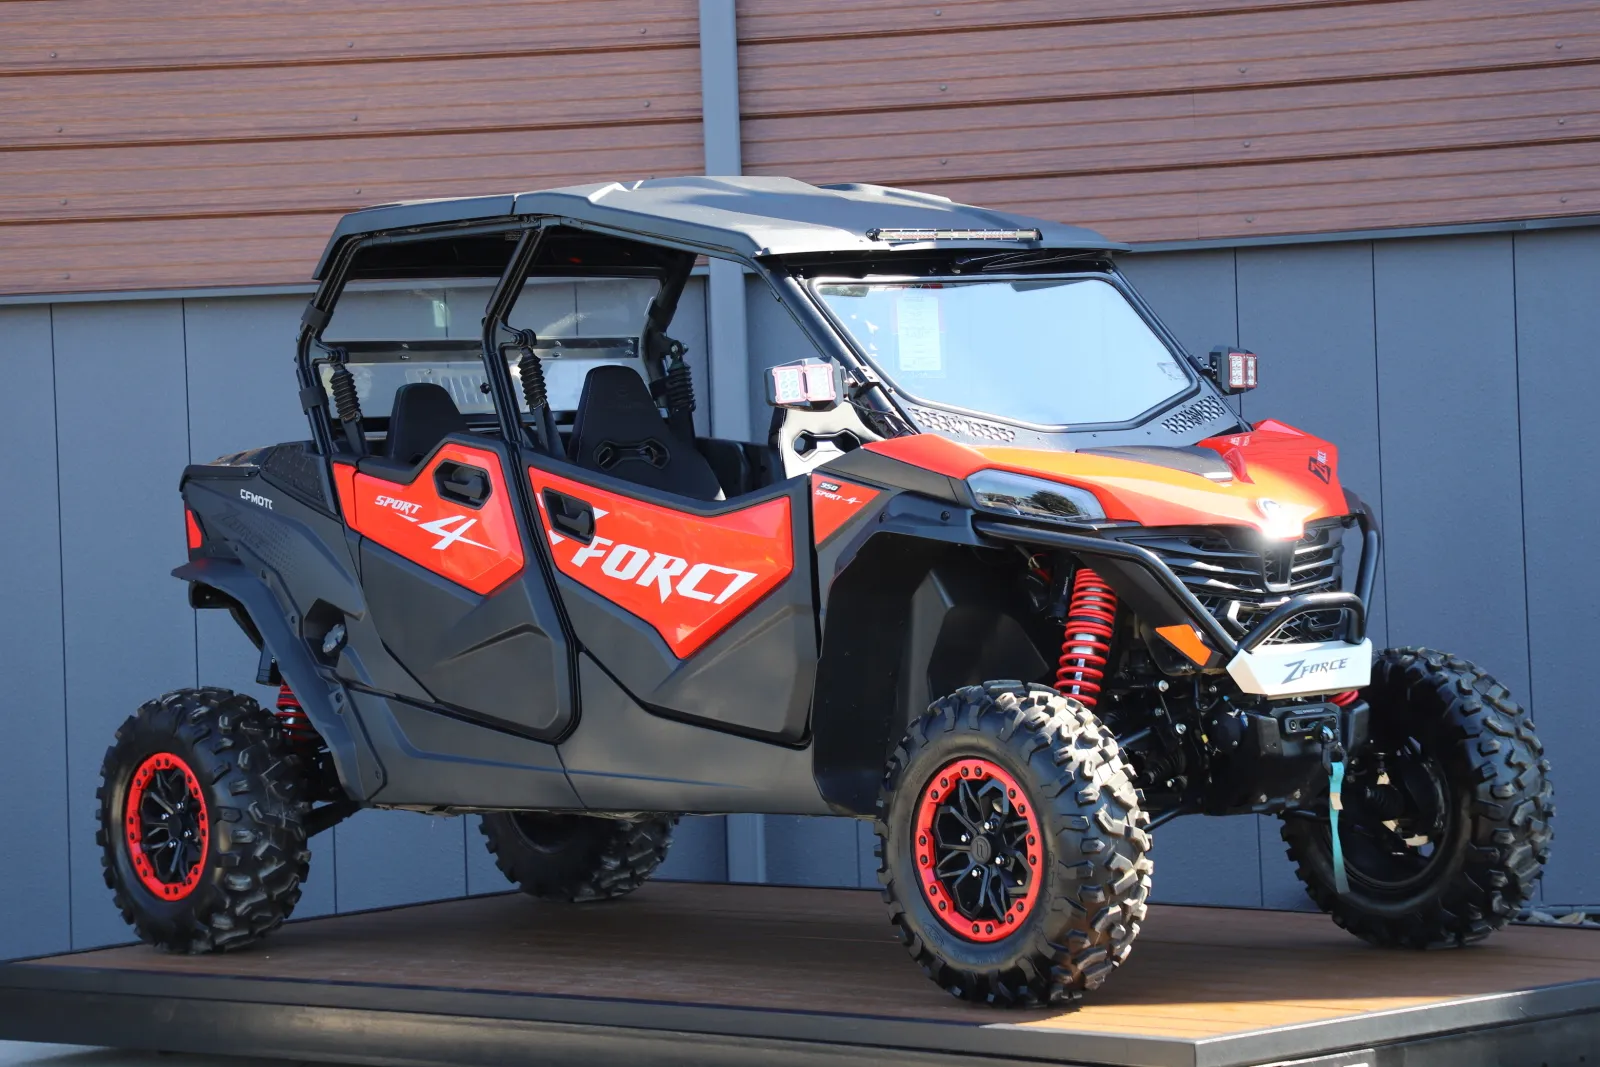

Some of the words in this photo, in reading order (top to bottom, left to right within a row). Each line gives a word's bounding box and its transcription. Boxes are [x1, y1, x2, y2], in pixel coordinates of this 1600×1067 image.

[374, 495, 423, 515] SPORT
[815, 490, 842, 500] SPORT
[417, 514, 499, 551] 4
